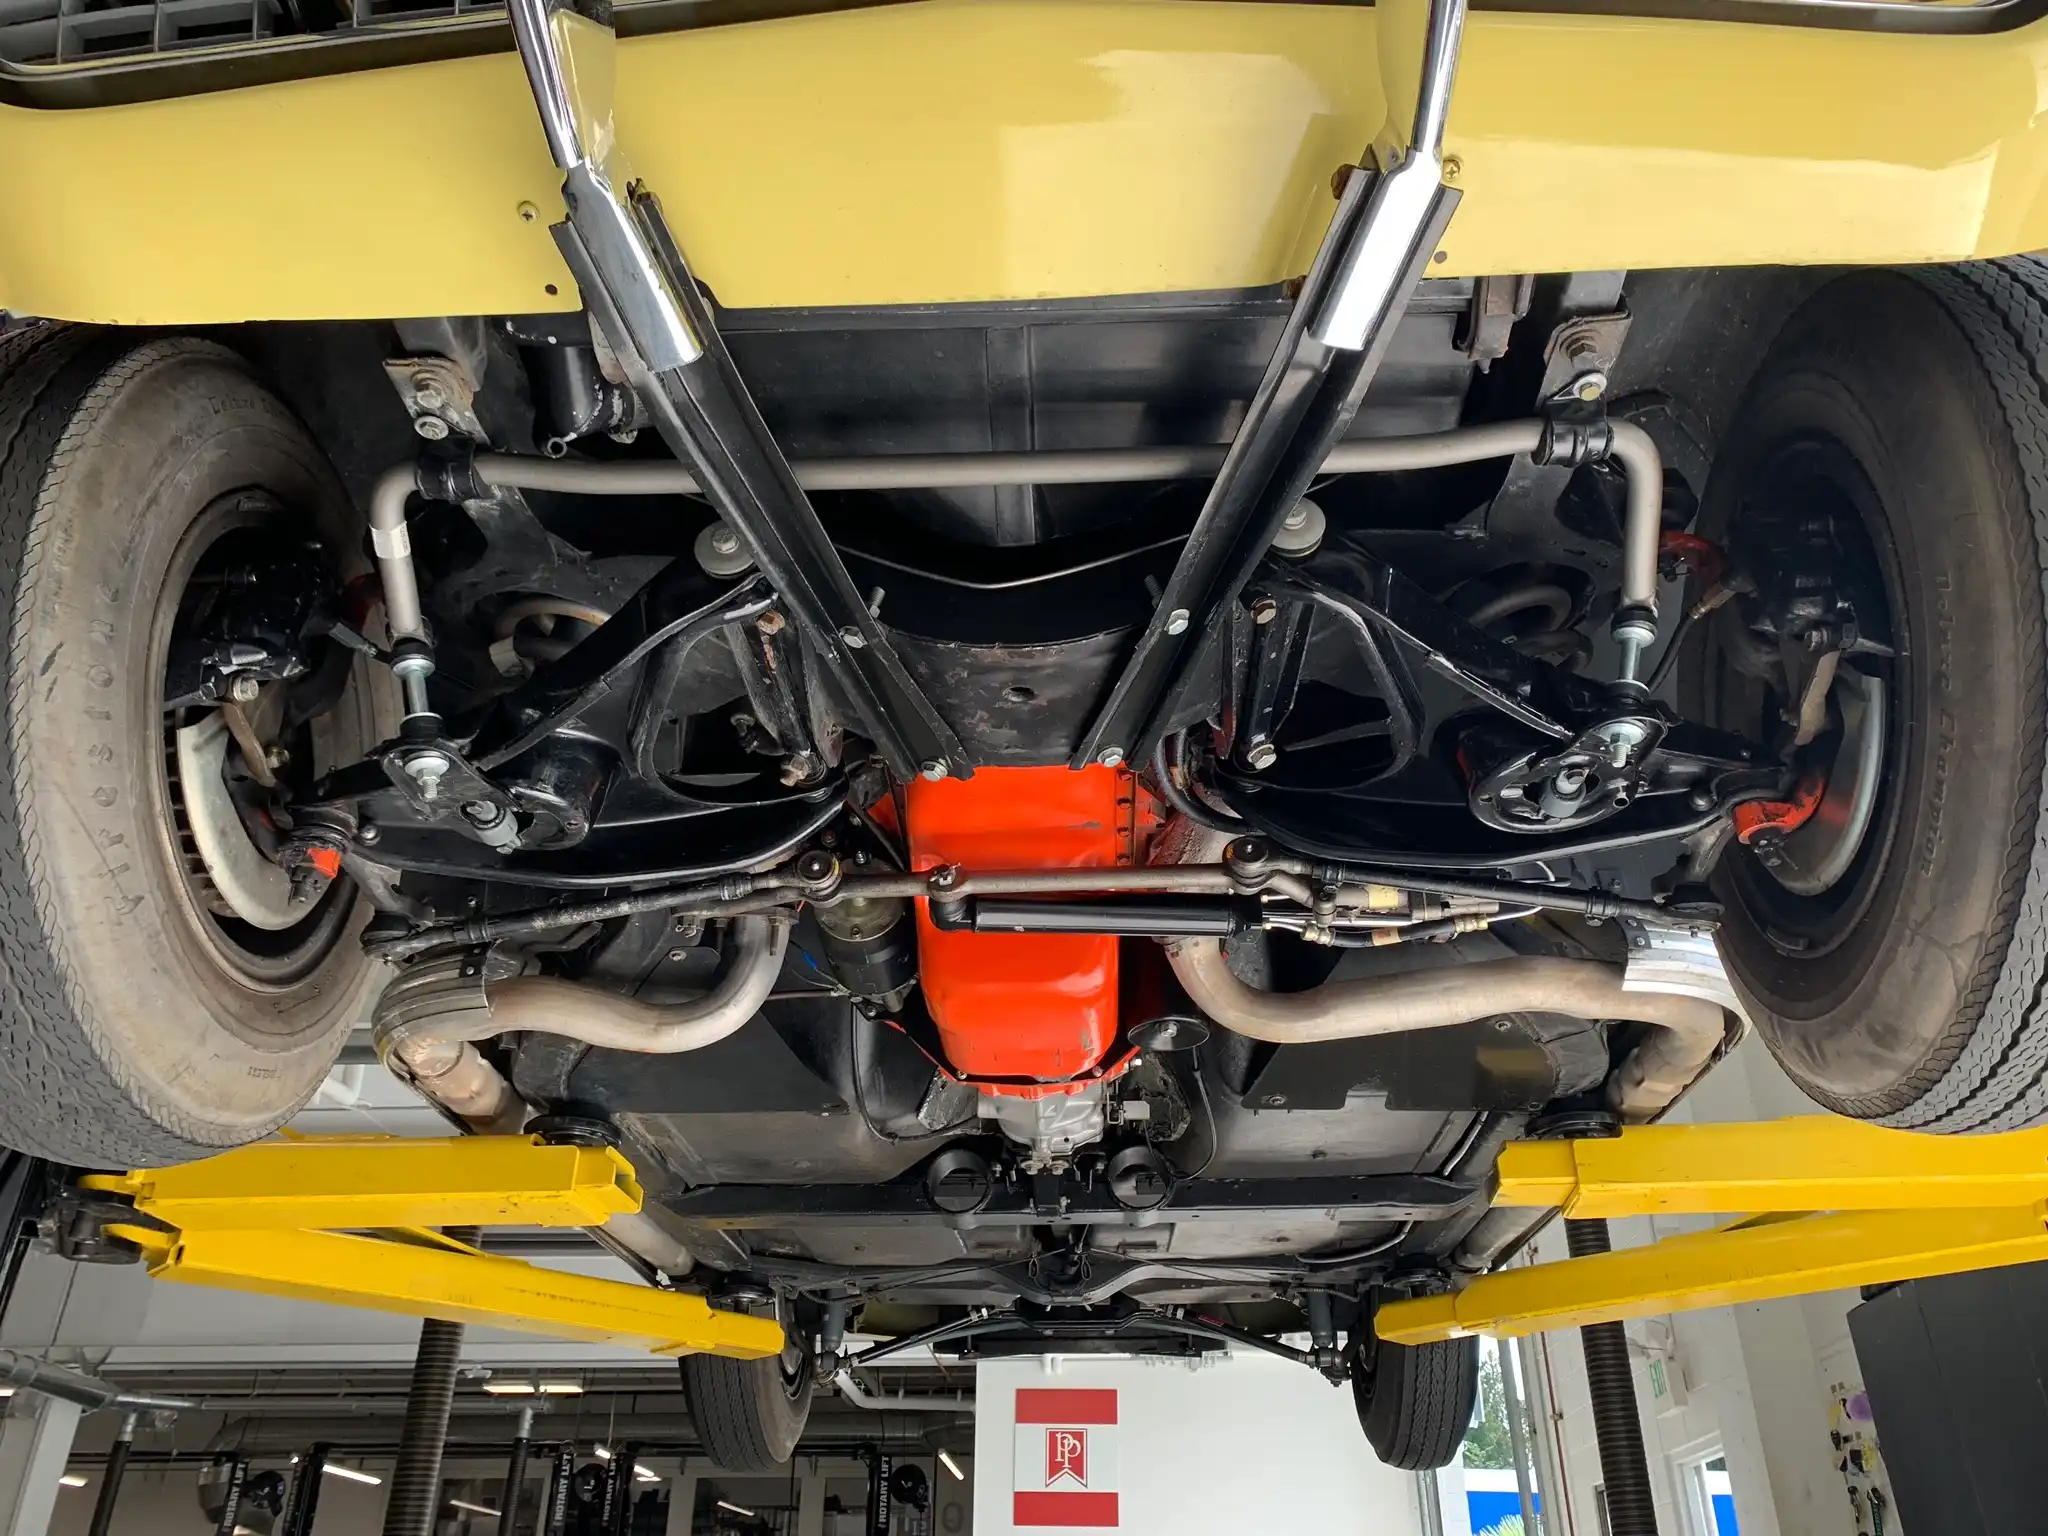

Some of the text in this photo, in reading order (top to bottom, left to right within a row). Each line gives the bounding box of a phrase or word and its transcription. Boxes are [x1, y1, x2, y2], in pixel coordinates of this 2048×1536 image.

[1648, 1358, 1668, 1399] EXIT
[223, 1462, 247, 1528] ROTARY LIFT
[554, 1453, 572, 1521] ROTARY LIFT
[602, 1478, 615, 1521] ROTARY
[878, 1455, 890, 1523] ROTARY LIFT
